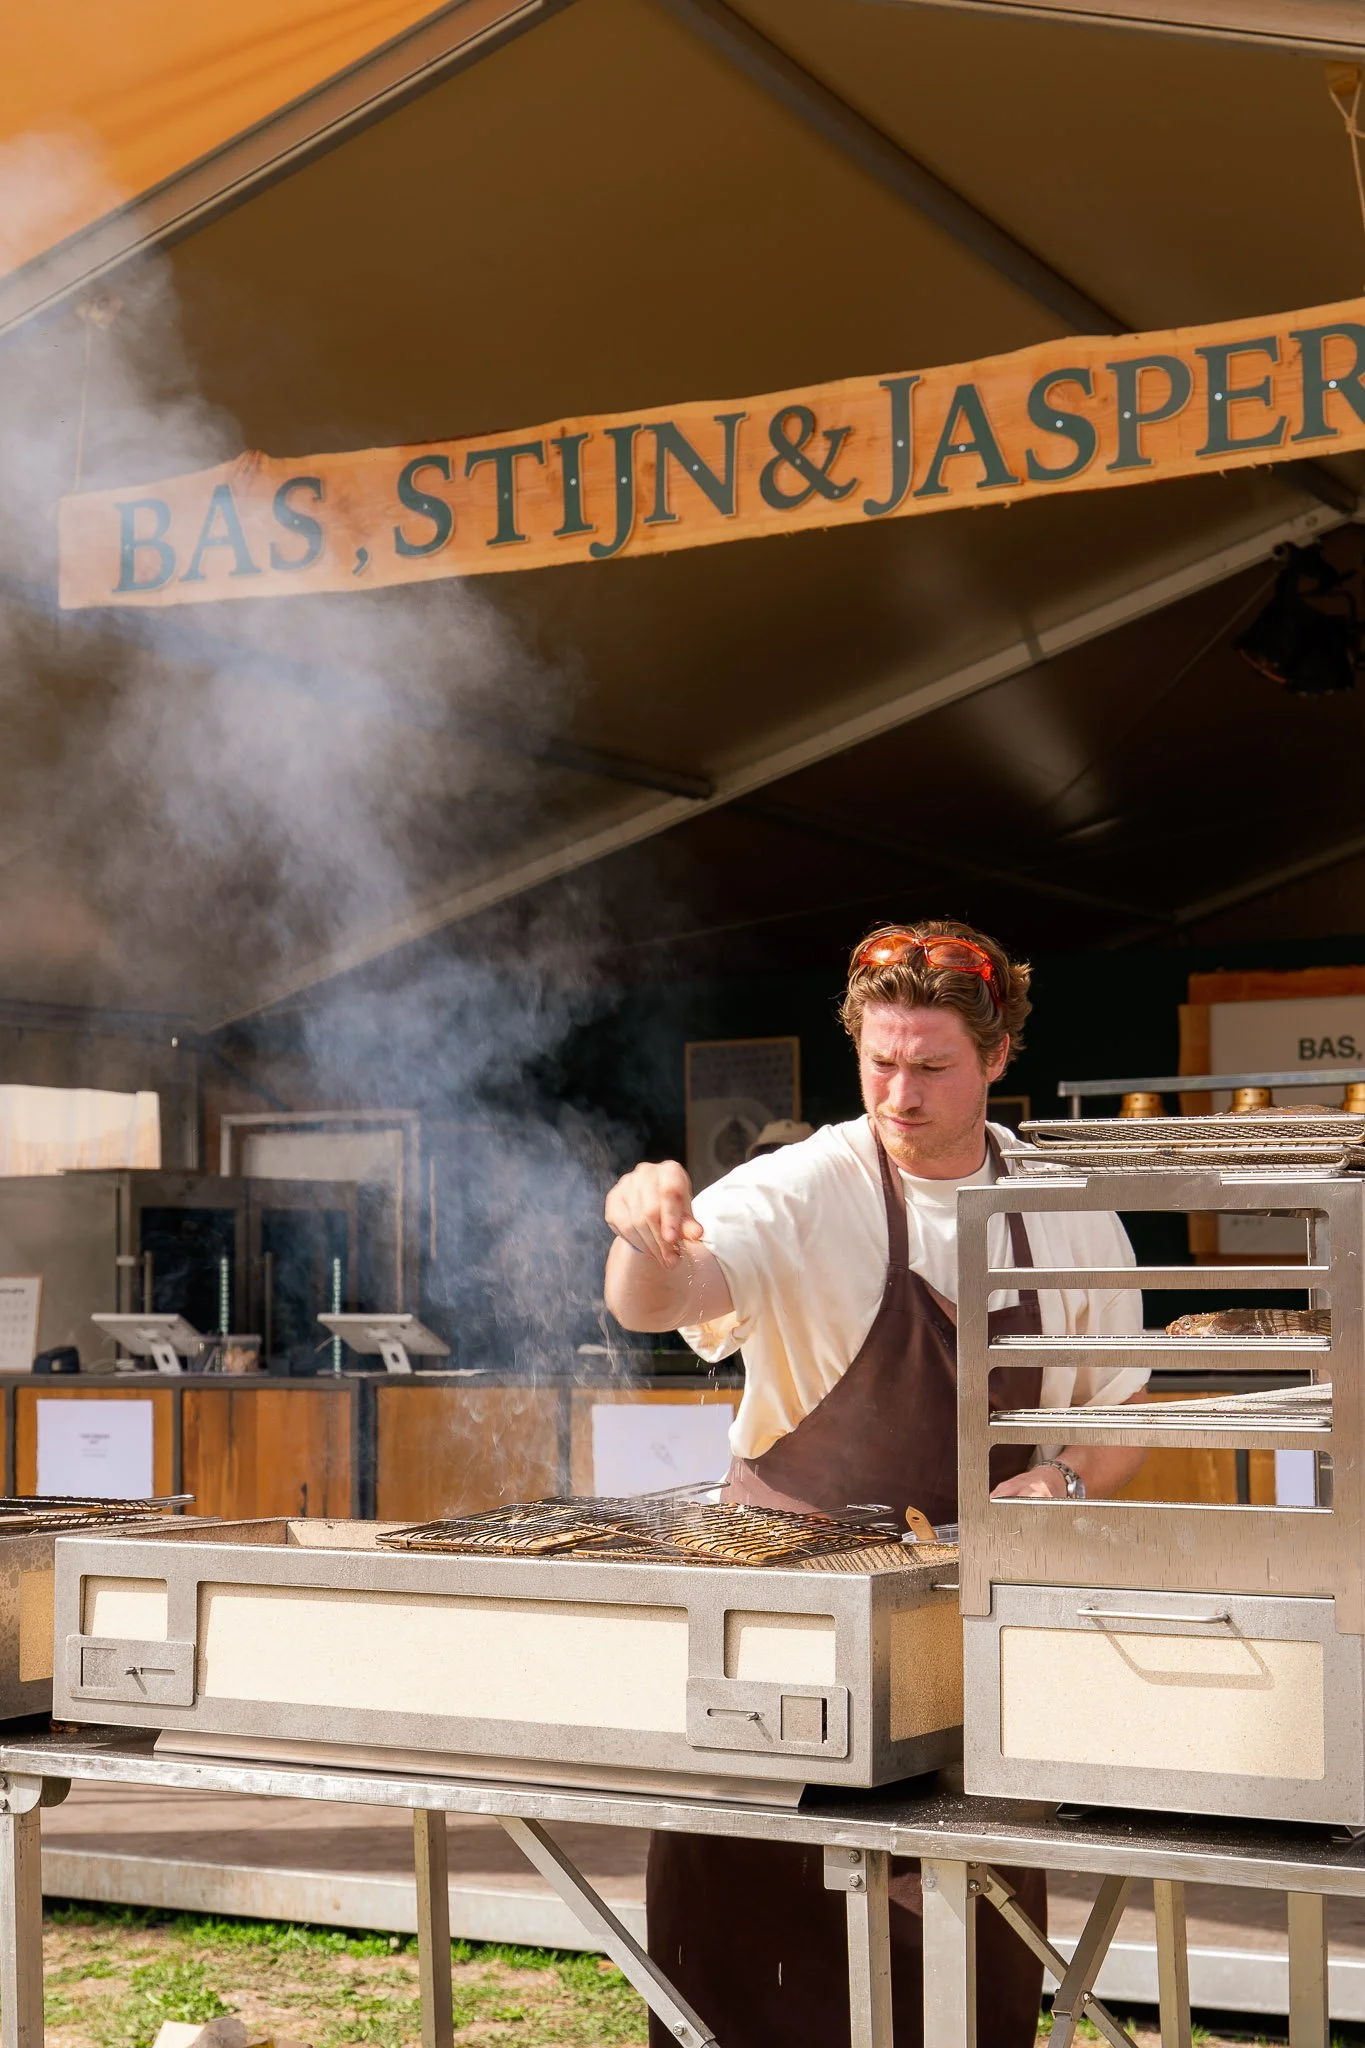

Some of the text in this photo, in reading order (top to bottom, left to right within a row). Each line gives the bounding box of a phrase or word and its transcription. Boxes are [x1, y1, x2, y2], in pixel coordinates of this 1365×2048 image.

[111, 475, 371, 594] BAS,
[394, 411, 747, 559] STIJN
[863, 323, 1365, 517] JASPER
[1298, 1034, 1363, 1062] BAS,
